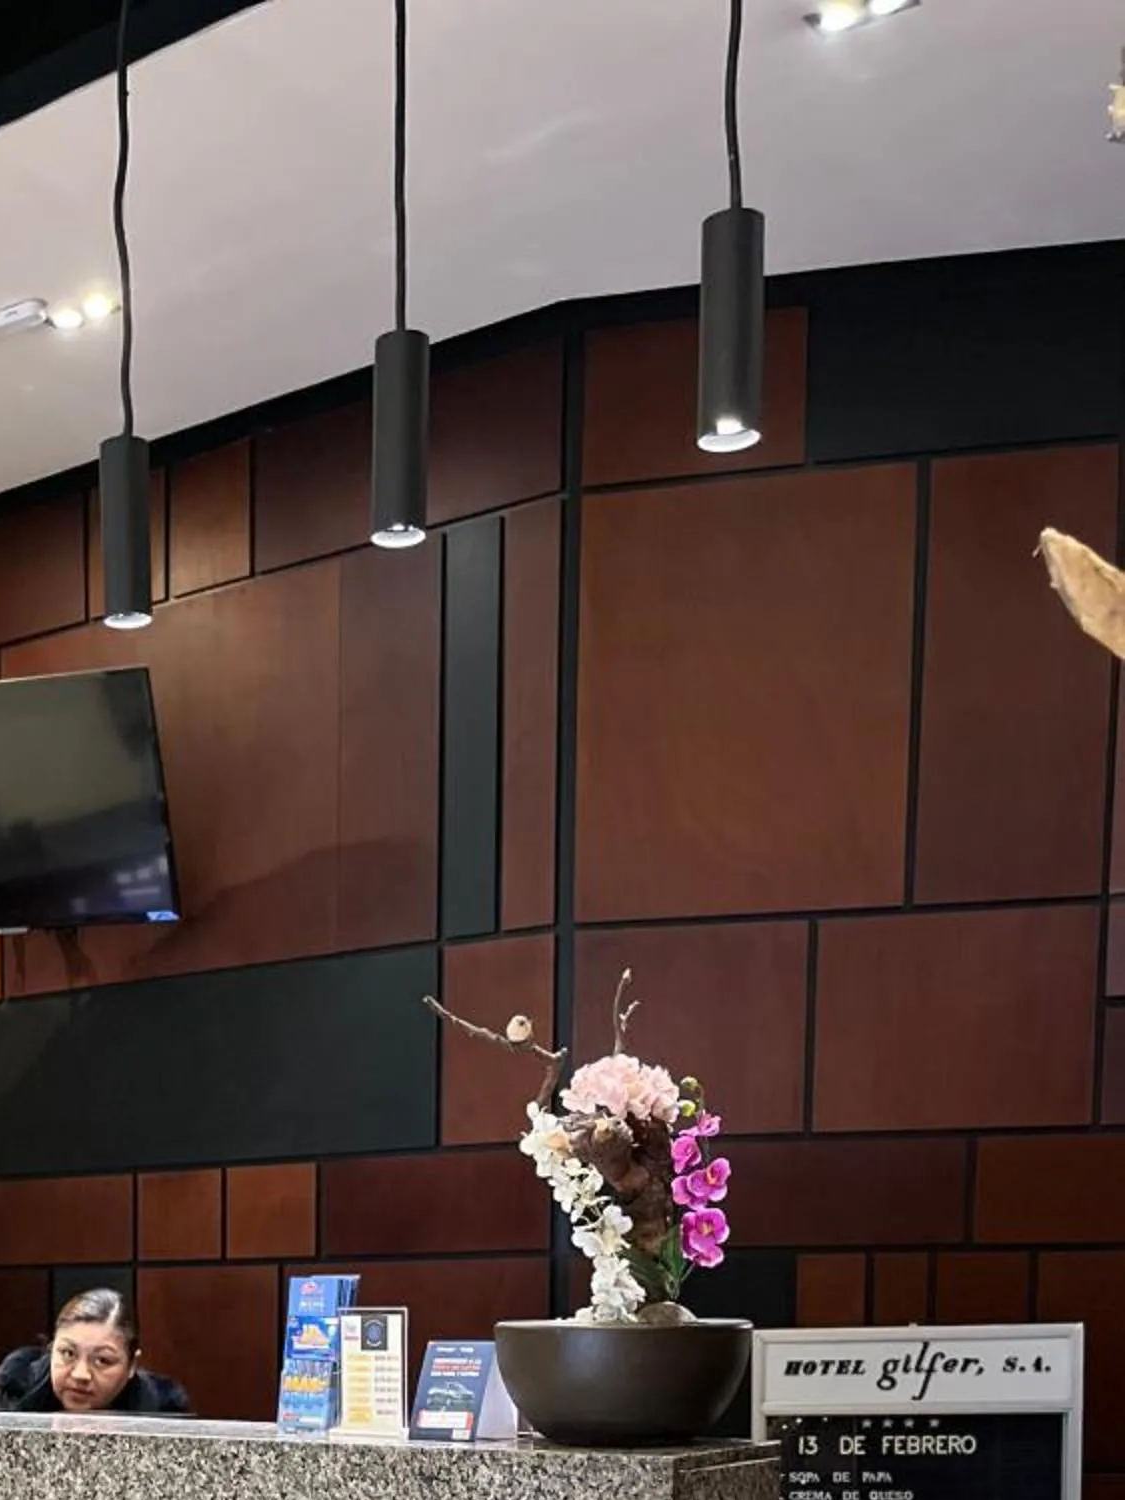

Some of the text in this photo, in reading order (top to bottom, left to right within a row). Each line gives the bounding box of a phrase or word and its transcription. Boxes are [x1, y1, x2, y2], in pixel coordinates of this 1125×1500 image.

[784, 1359, 866, 1377] HOTEL
[798, 1434, 977, 1455] 13 DE FEBRERO
[788, 1471, 893, 1484] SOPA DE PAPA
[841, 1490, 860, 1500] DE
